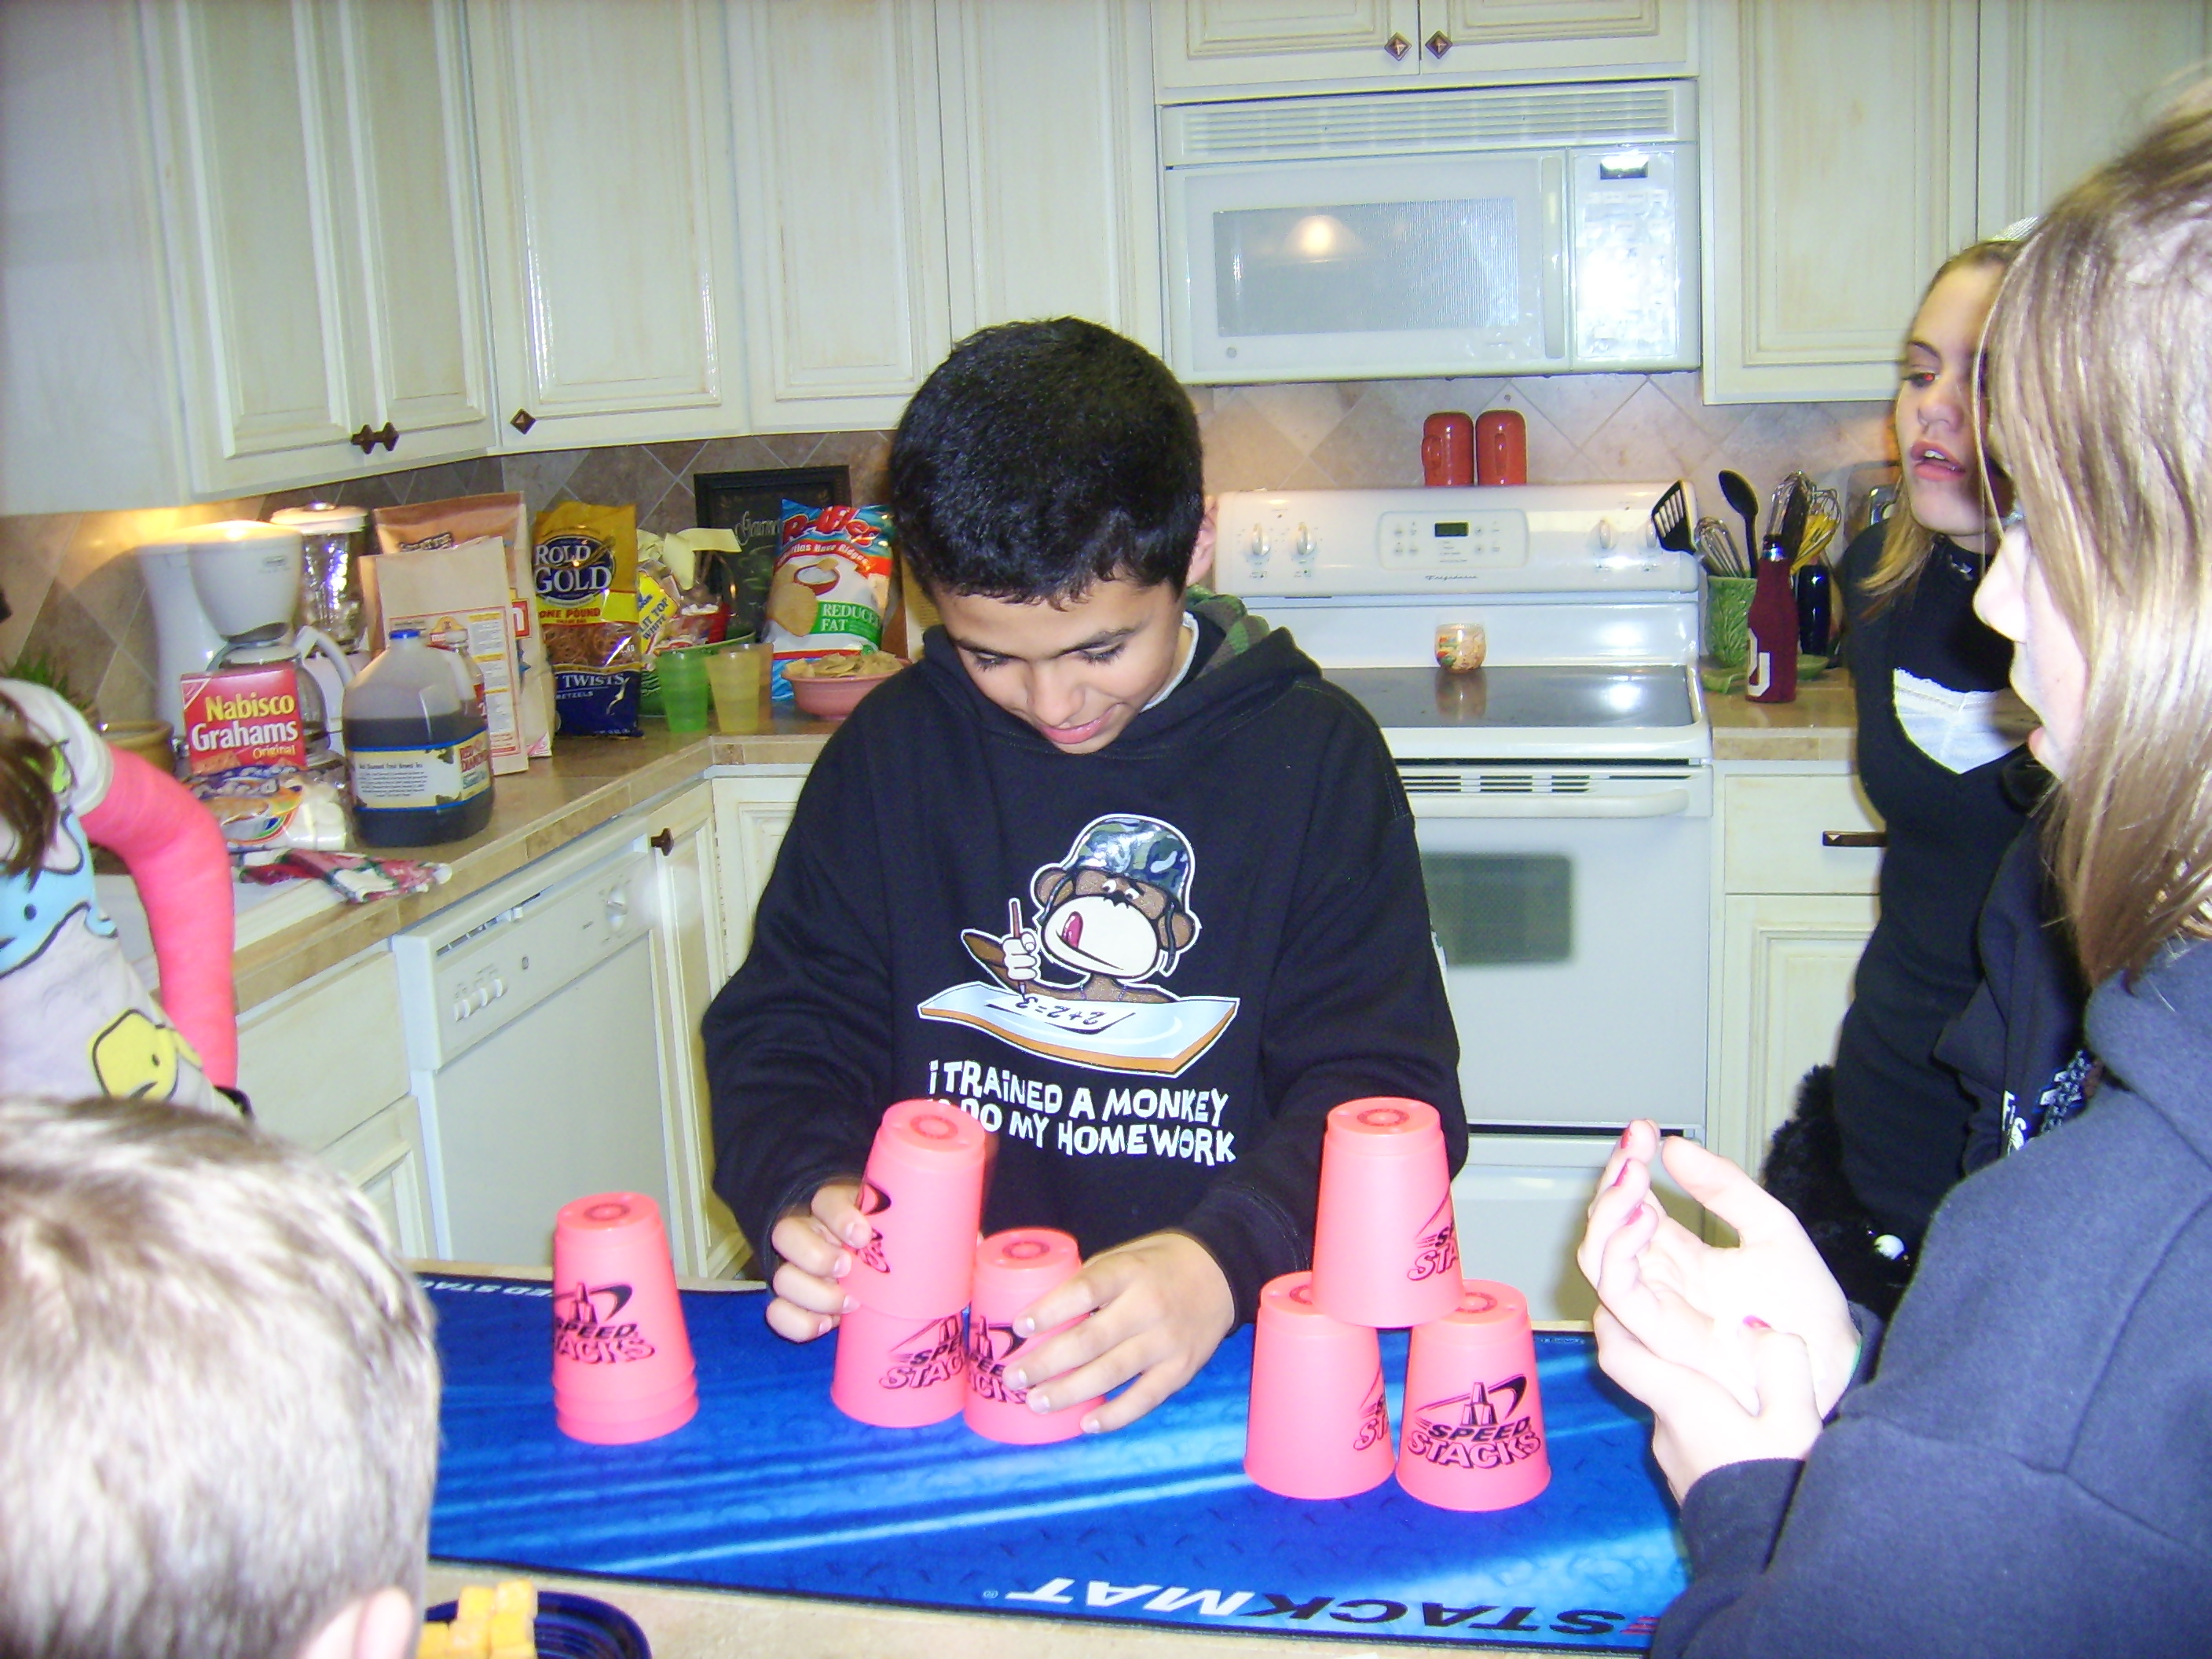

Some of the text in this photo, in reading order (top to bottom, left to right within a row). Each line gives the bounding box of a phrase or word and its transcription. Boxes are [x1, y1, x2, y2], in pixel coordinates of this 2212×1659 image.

[536, 544, 591, 566] ROLD
[535, 566, 613, 593] GOLD
[821, 619, 848, 632] FAT
[562, 672, 624, 688] TWISTS
[205, 692, 295, 722] Nabisco
[192, 720, 298, 752] Grahams
[252, 745, 296, 759] Original
[1069, 1088, 1095, 1120] A
[1102, 1087, 1229, 1127] MONKEY
[1009, 1111, 1049, 1148] MY
[1058, 1119, 1236, 1166] HOMEWORK
[1428, 1416, 1531, 1442] SPEED
[1407, 1428, 1541, 1469] STACKS
